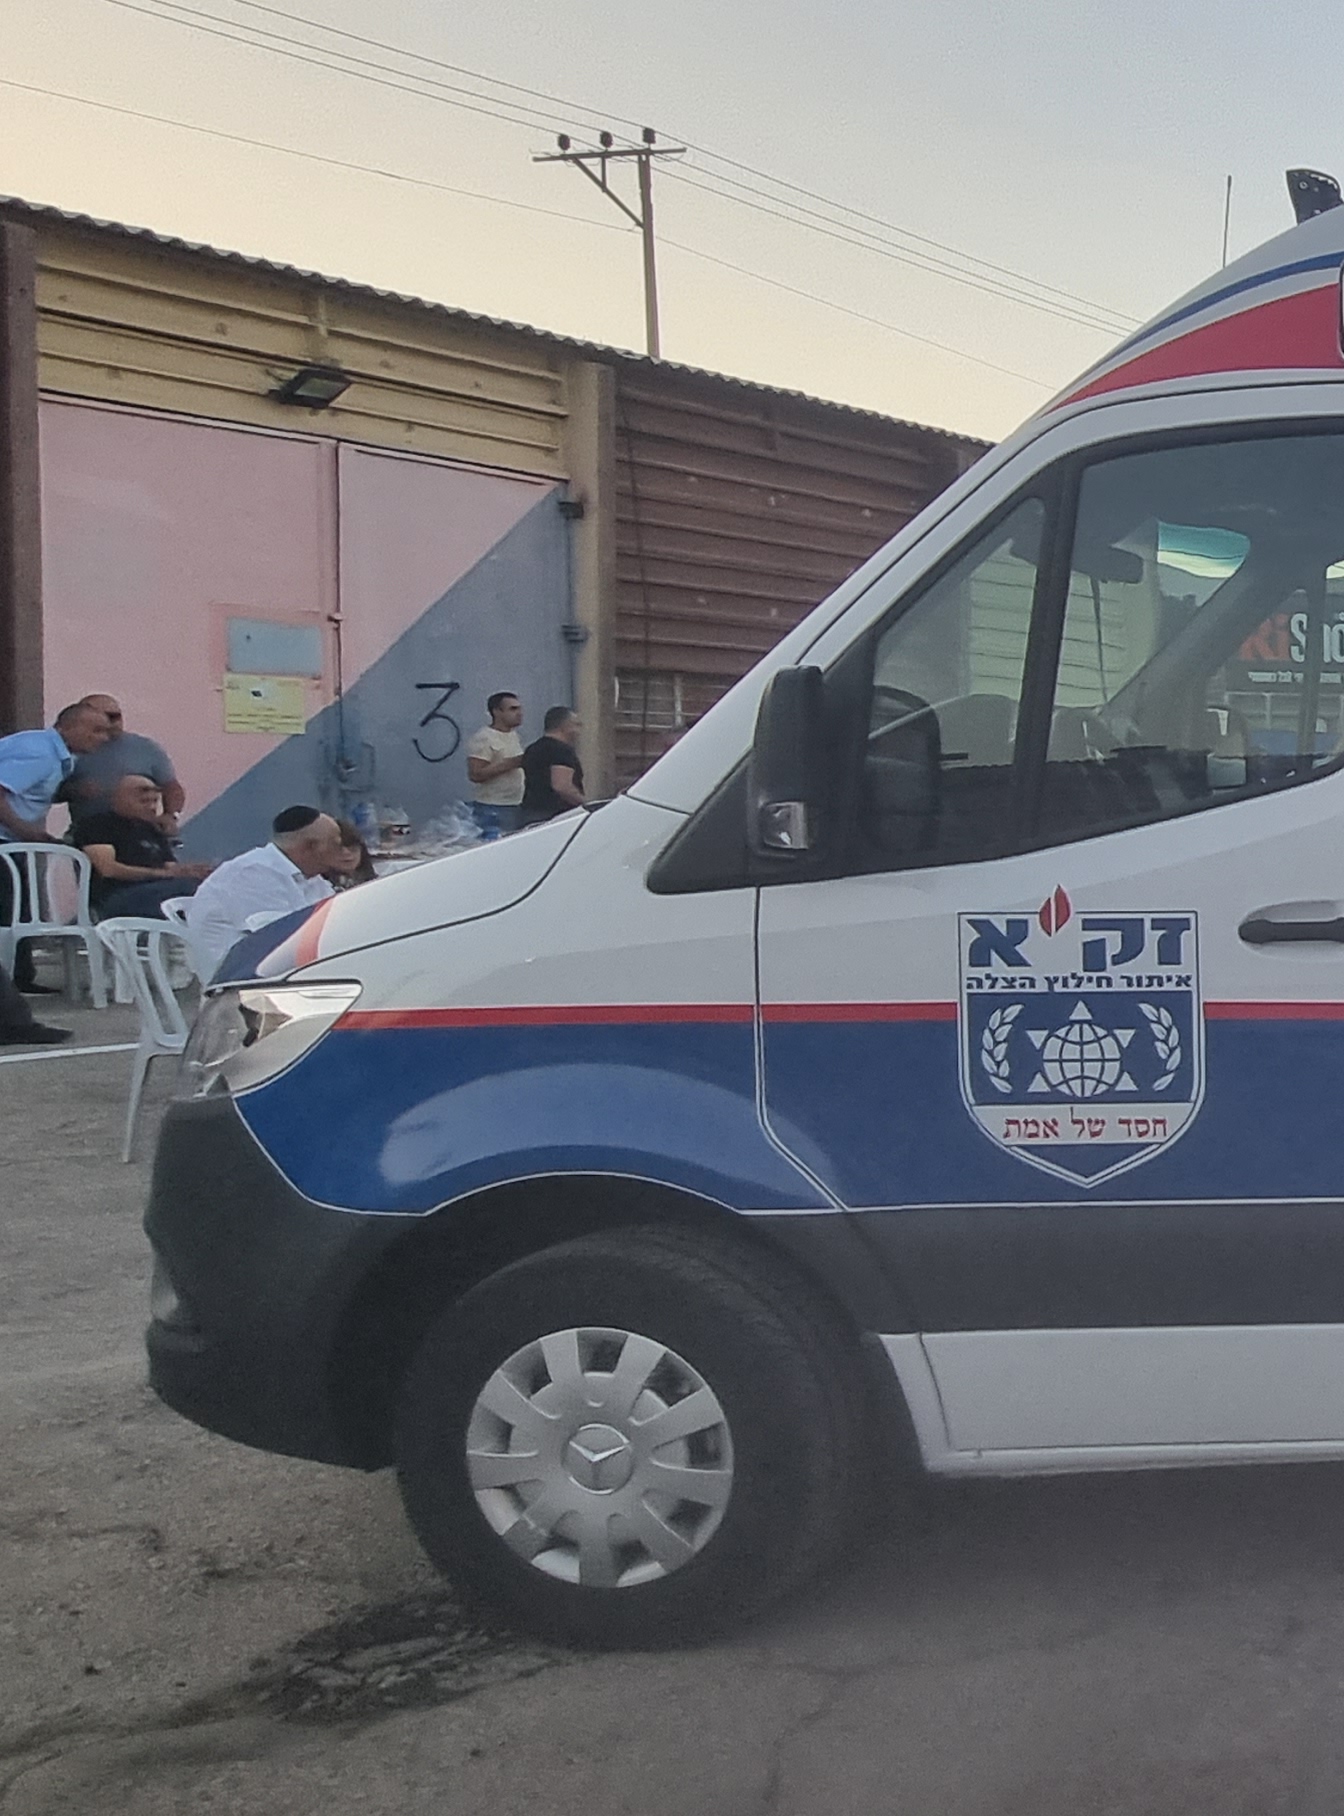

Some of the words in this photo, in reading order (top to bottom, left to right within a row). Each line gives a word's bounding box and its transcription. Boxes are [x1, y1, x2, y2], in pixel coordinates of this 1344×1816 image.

[413, 683, 461, 763] 3
[966, 973, 1036, 990] הצלה
[1044, 972, 1112, 992] חילוץ
[1119, 974, 1192, 989] איתור
[1002, 1118, 1059, 1139] אמת
[1070, 1107, 1105, 1138] של
[1117, 1118, 1168, 1138] חסד
